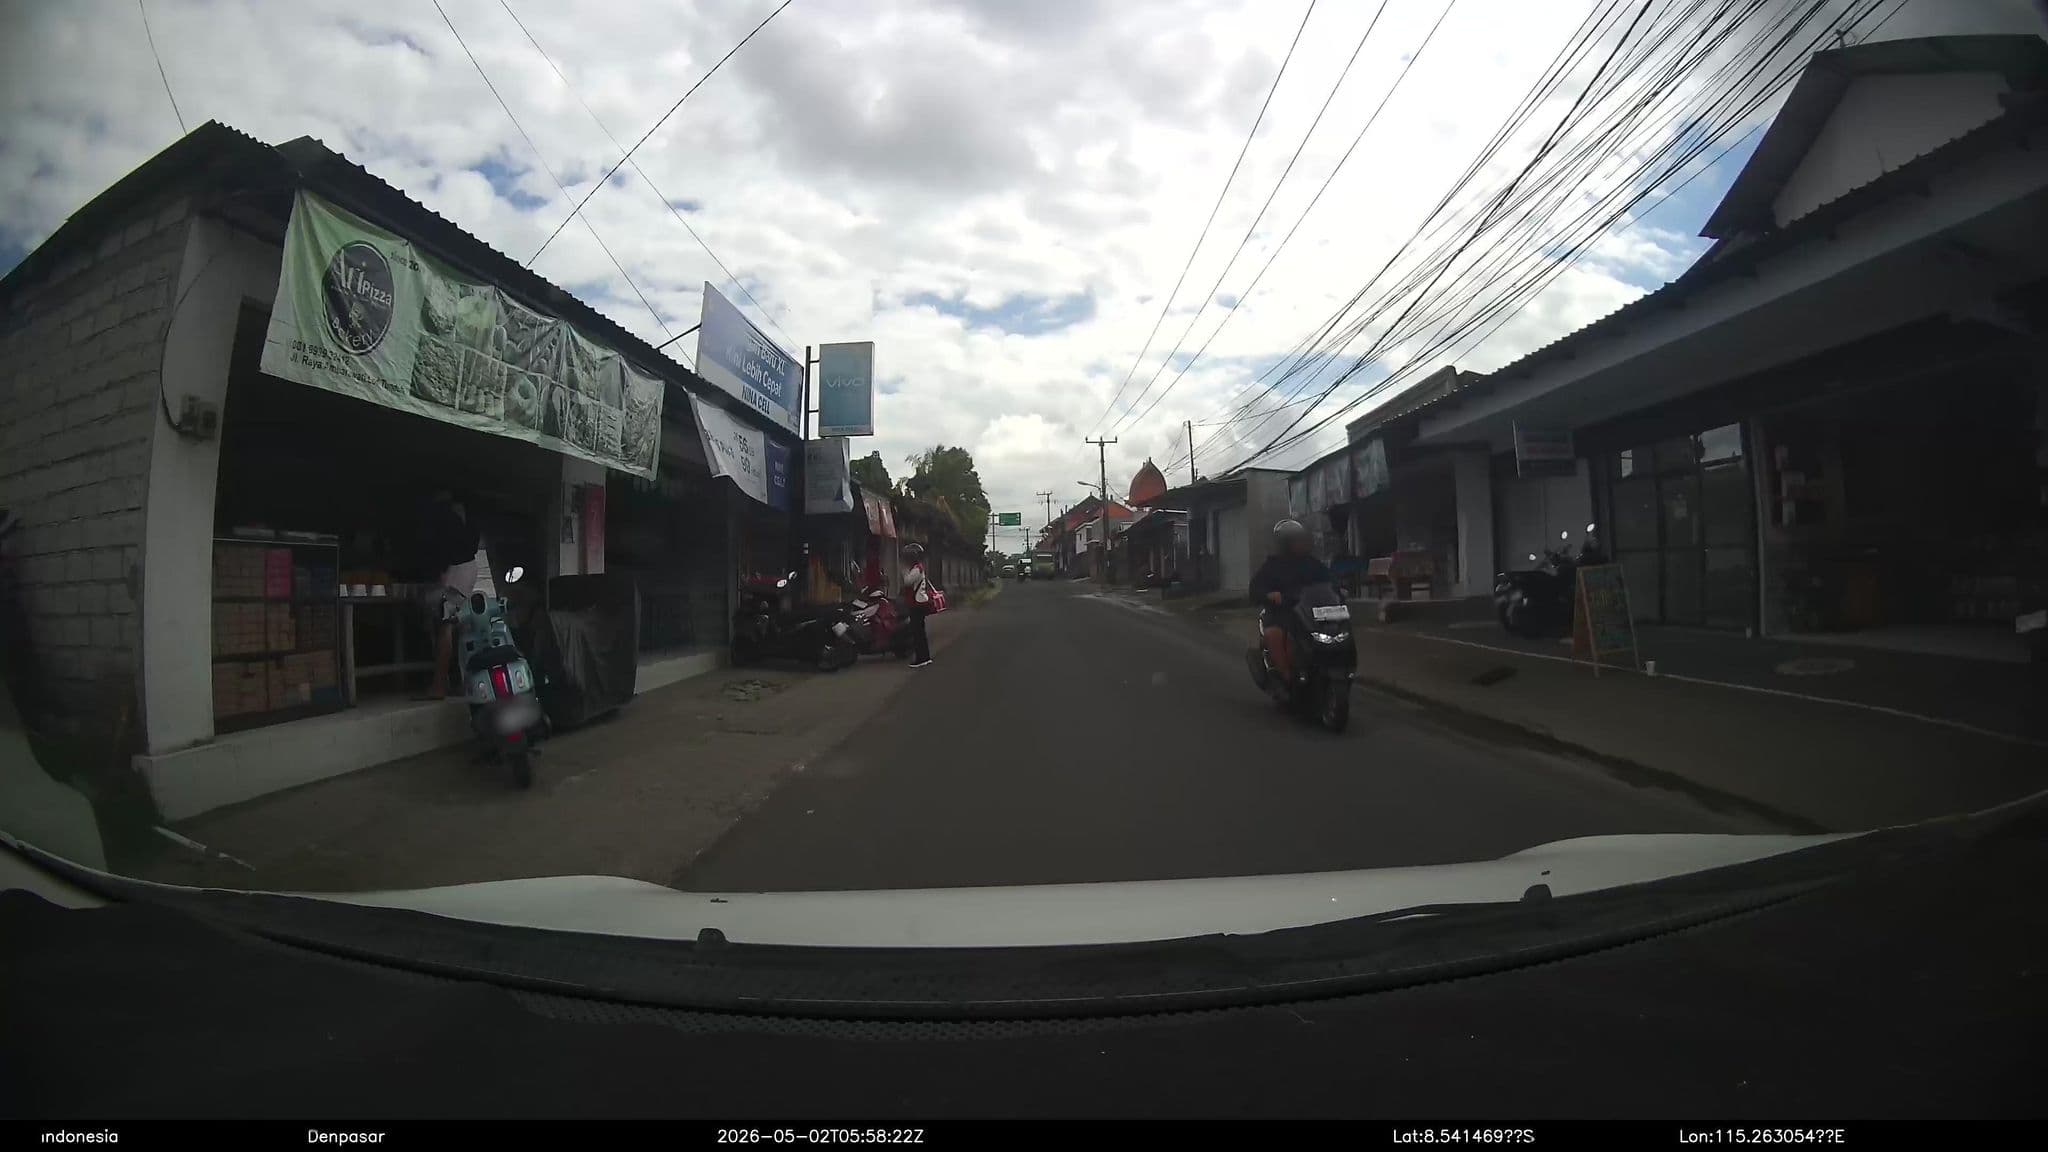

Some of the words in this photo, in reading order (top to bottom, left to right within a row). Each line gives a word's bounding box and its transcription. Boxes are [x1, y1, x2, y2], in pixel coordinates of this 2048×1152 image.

[362, 280, 391, 306] Pizza
[302, 355, 322, 369] Raya
[777, 357, 785, 376] XL
[742, 354, 762, 383] Lebih
[762, 371, 782, 397] Cepat
[826, 375, 864, 388] vivo
